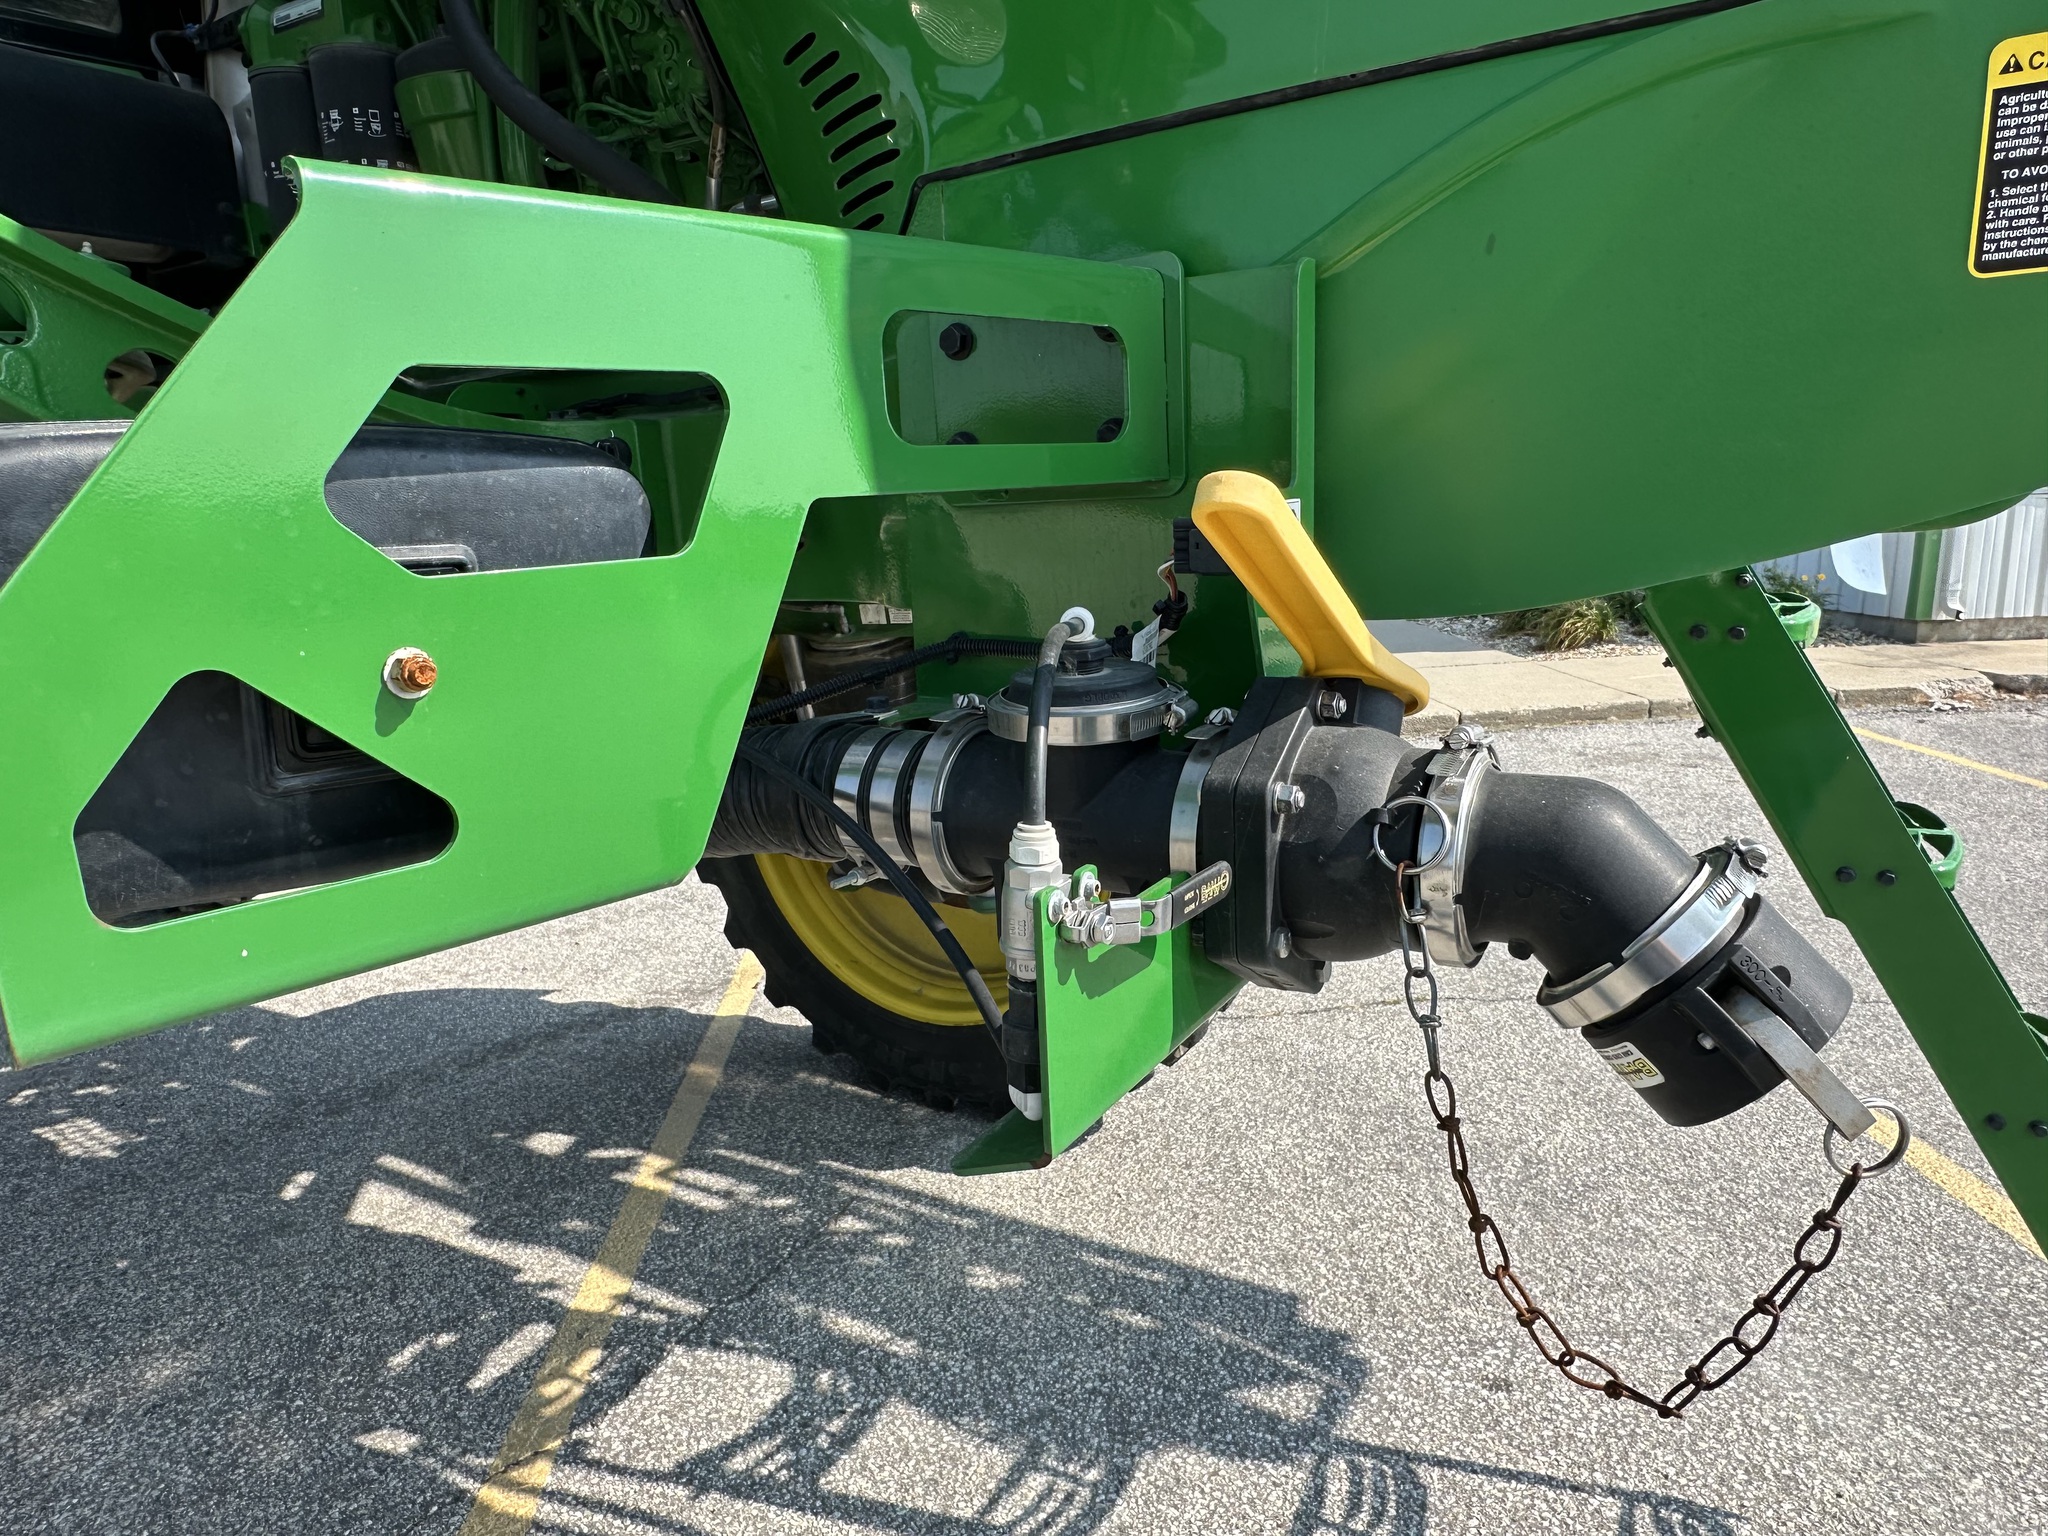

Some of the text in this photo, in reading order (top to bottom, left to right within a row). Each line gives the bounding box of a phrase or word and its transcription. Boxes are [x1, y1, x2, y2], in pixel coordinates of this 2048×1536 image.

[2028, 51, 2048, 70] C
[1998, 106, 2019, 116] can
[2022, 104, 2037, 113] be
[1996, 128, 2016, 139] use
[2020, 125, 2040, 135] can
[1994, 135, 2042, 150] animals,
[1993, 151, 2006, 161] or
[2008, 147, 2039, 158] other
[2001, 169, 2019, 180] TO
[1990, 188, 1999, 198] 1.
[2002, 184, 2038, 196] Select
[1988, 193, 2039, 208] chemical
[1986, 210, 1996, 219] 2.
[2000, 205, 2039, 218] Handle
[1985, 219, 2009, 230] with
[2012, 217, 2039, 227] care.
[1983, 242, 1997, 252] by
[2000, 239, 2018, 249] the
